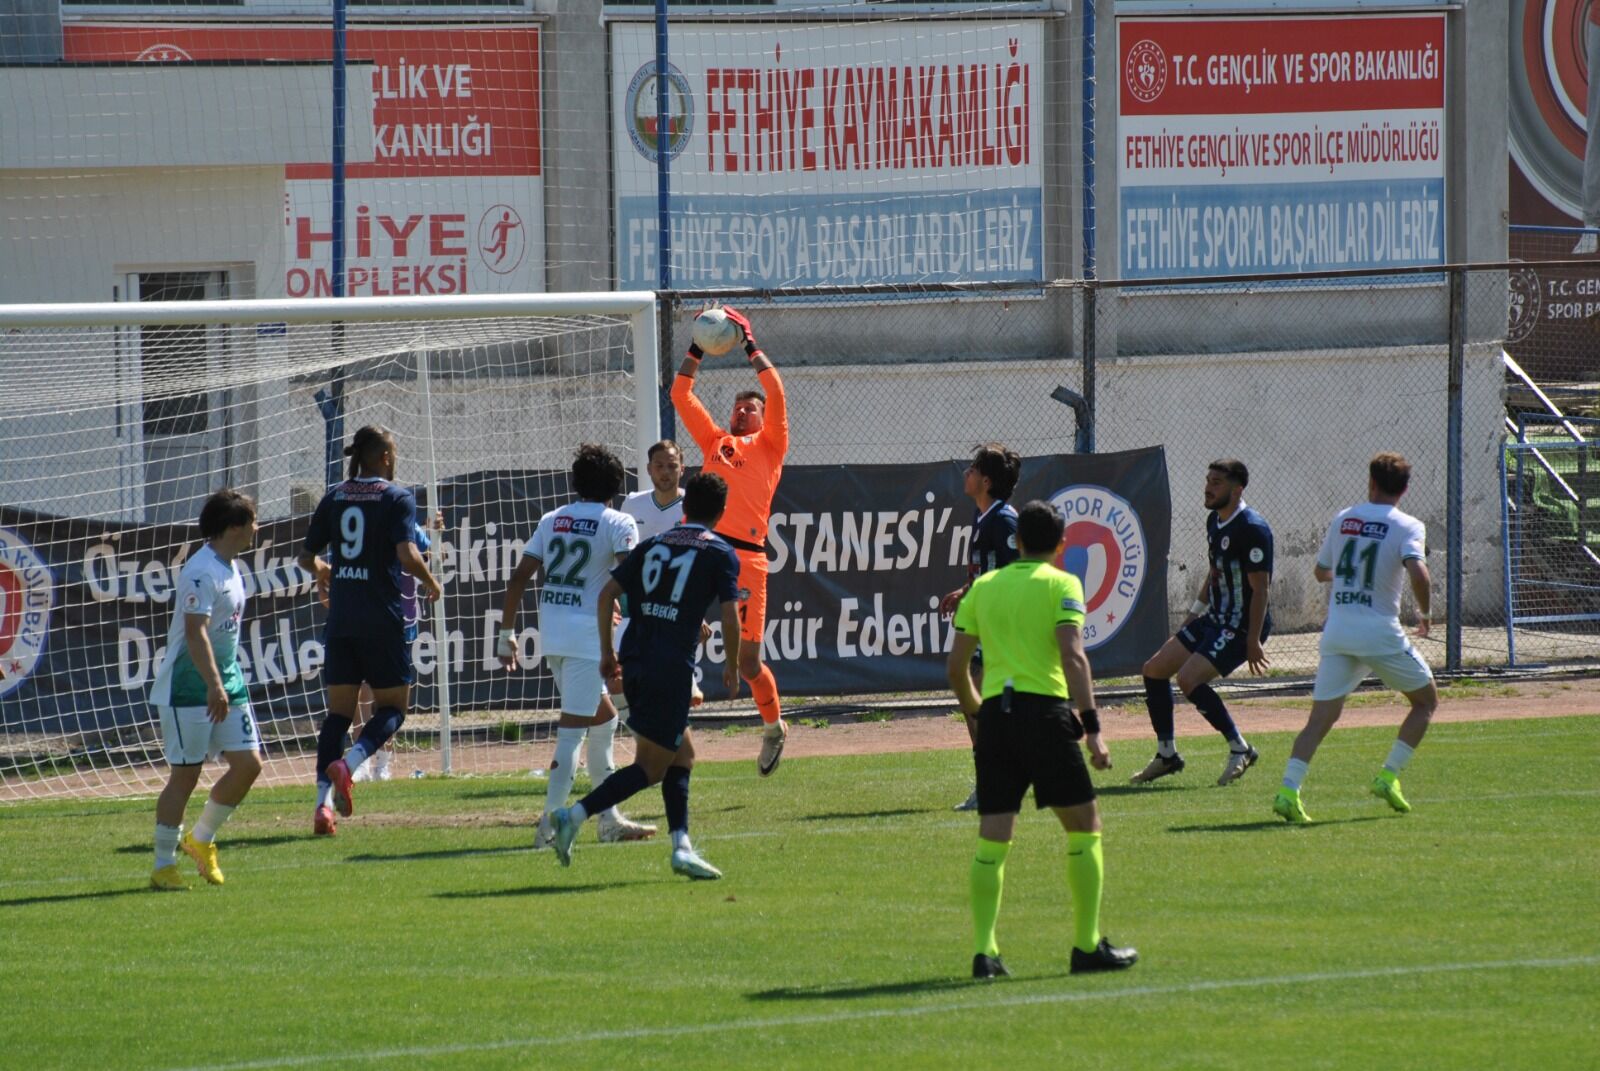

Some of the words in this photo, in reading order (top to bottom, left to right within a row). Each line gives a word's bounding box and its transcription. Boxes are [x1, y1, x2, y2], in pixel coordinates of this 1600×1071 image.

[432, 63, 473, 98] VE
[1172, 55, 1203, 86] T.C.
[1206, 48, 1278, 94] GENÇLİK
[1283, 53, 1304, 84] VE
[1309, 51, 1351, 83] SPOR
[1355, 42, 1439, 81] BAKANLIĞI
[706, 42, 816, 172] FETHİYE
[823, 37, 1031, 171] KAYMAKAMLIĞI
[373, 114, 492, 158] KANLIĞI
[1126, 127, 1185, 169] FETHİYE
[1187, 126, 1250, 177] GENÇLİK
[1251, 134, 1270, 167] VE
[1273, 131, 1311, 166] SPOR
[1314, 124, 1344, 174] İLÇE
[1347, 121, 1439, 164] MÜDÜRLÜĞÜ
[629, 201, 724, 281] FEHİYE
[816, 211, 944, 286] BAŞARILAR
[950, 194, 1033, 273] DİLERİZ
[1127, 191, 1200, 270] FETHİYE
[1270, 201, 1369, 272] BAŞARILAR
[1372, 184, 1440, 262] DİLERİZ
[286, 257, 468, 298] OMPLEKSİ
[1547, 303, 1582, 320] SPOR
[340, 505, 365, 560] 9
[1105, 506, 1141, 599] KULÜBÜ
[545, 536, 590, 587] 22
[641, 543, 698, 604] 61
[1335, 537, 1380, 591] 41
